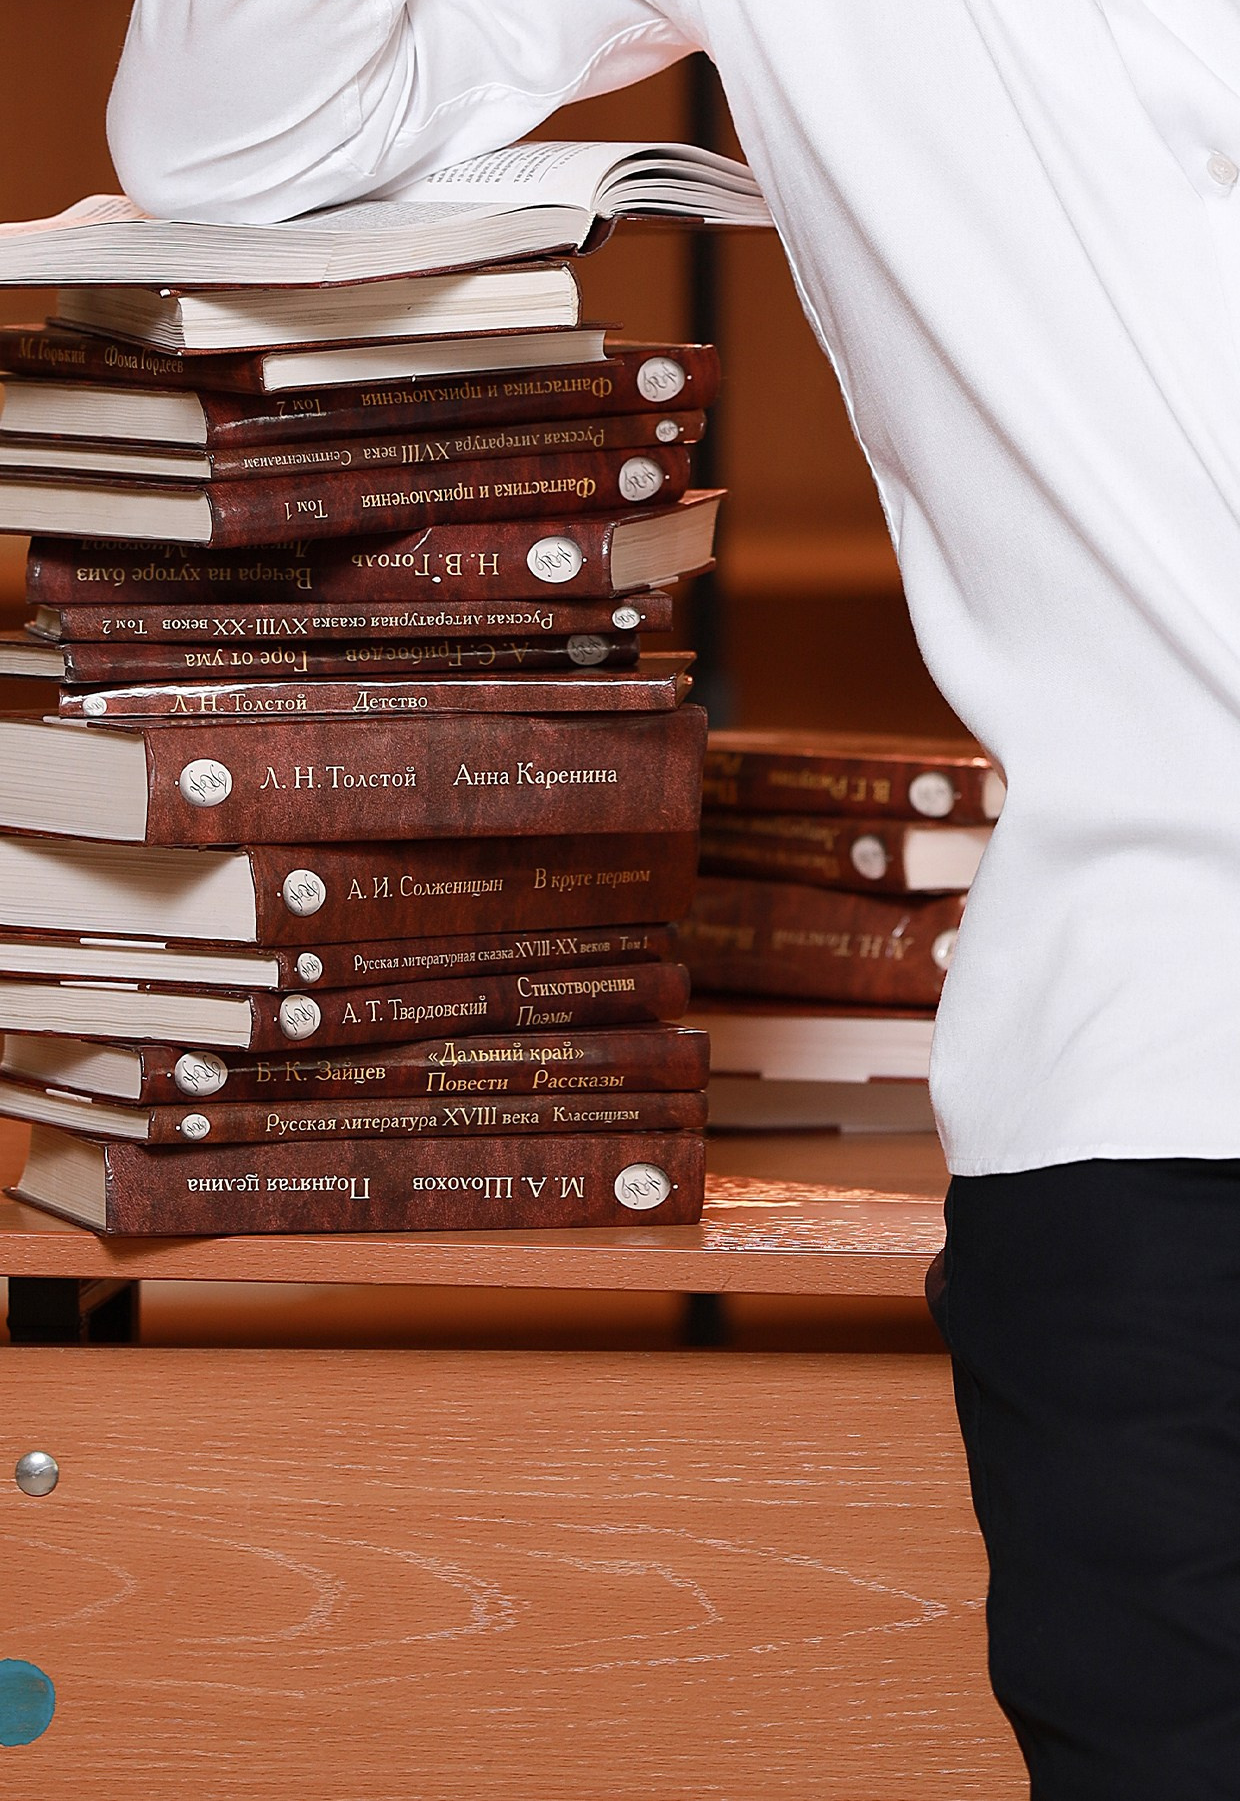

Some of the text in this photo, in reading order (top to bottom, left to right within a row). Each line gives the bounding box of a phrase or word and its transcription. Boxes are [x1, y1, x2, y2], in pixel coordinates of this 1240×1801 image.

[18, 338, 184, 376] М. Горький Фома Гордеев
[277, 377, 612, 417] Фантастика и приключения Том 2
[242, 425, 605, 468] Русская литература XVIII века Сентиментализм
[361, 484, 474, 508] приключения
[479, 485, 489, 496] и
[494, 477, 596, 497] Фантастика
[284, 503, 292, 520] 1
[297, 499, 328, 519] Том
[76, 563, 313, 590] Вечера на хуторе близ
[351, 553, 430, 576] Гоголь
[438, 553, 463, 576] В.
[470, 553, 500, 576] Н.
[102, 609, 554, 636] Русская литературная сказка XVIII-XX веков Том 2
[184, 646, 308, 673] Горе от ума
[345, 641, 462, 667] Грибоедов
[170, 691, 428, 713] Л. Н. Толстой Детство
[259, 767, 287, 790] Л.
[294, 767, 322, 790] Н.
[325, 765, 417, 789] Толстой
[453, 763, 510, 786] Анна
[515, 761, 618, 790] Каренина
[346, 878, 367, 901] А.
[373, 877, 394, 899] И.
[400, 875, 504, 898] Солженицын
[533, 868, 547, 889] В
[551, 872, 592, 891] круге
[596, 868, 652, 886] первом
[354, 936, 648, 974] Русская литературная сказка XVIII-XX веков Том 1
[517, 976, 635, 998] Стихотворения
[342, 1003, 361, 1024] А.
[366, 1000, 384, 1022] Т.
[387, 994, 488, 1023] Твардовский
[515, 1005, 573, 1027] Поэмы
[428, 1041, 585, 1067] «Дальний край»
[256, 1059, 386, 1084] Б. К. Зайцев
[426, 1069, 625, 1092] Повести Рассказы
[265, 1105, 640, 1133] Русская литература XVIII века Классицизм
[186, 1175, 371, 1200] Поднятая целина
[412, 1176, 585, 1199] М. А. Шолохов
